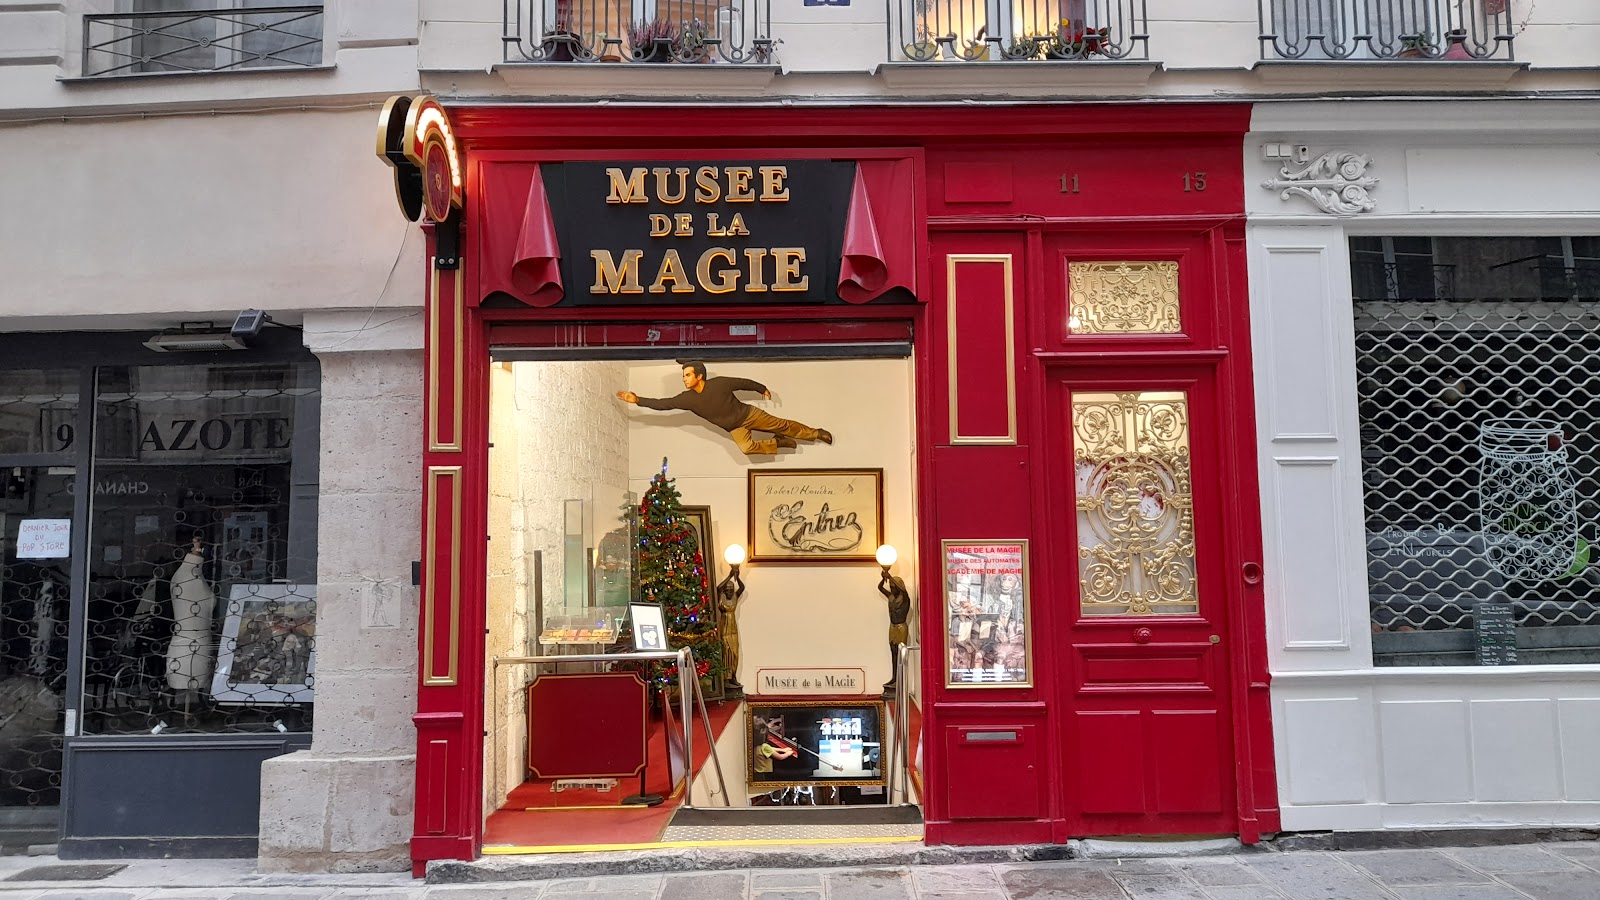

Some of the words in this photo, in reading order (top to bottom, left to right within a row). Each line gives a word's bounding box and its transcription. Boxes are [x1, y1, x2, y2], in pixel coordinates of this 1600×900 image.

[605, 165, 790, 205] MUSEE
[1060, 173, 1080, 193] 11
[1183, 172, 1207, 192] 13
[648, 213, 694, 238] DE
[706, 212, 750, 237] LA
[589, 246, 809, 295] MAGIE
[56, 424, 74, 452] 9
[138, 417, 291, 452] AZOTE
[22, 542, 36, 552] POP
[765, 676, 798, 688] MUSÉE
[802, 679, 811, 687] de
[815, 679, 822, 687] la
